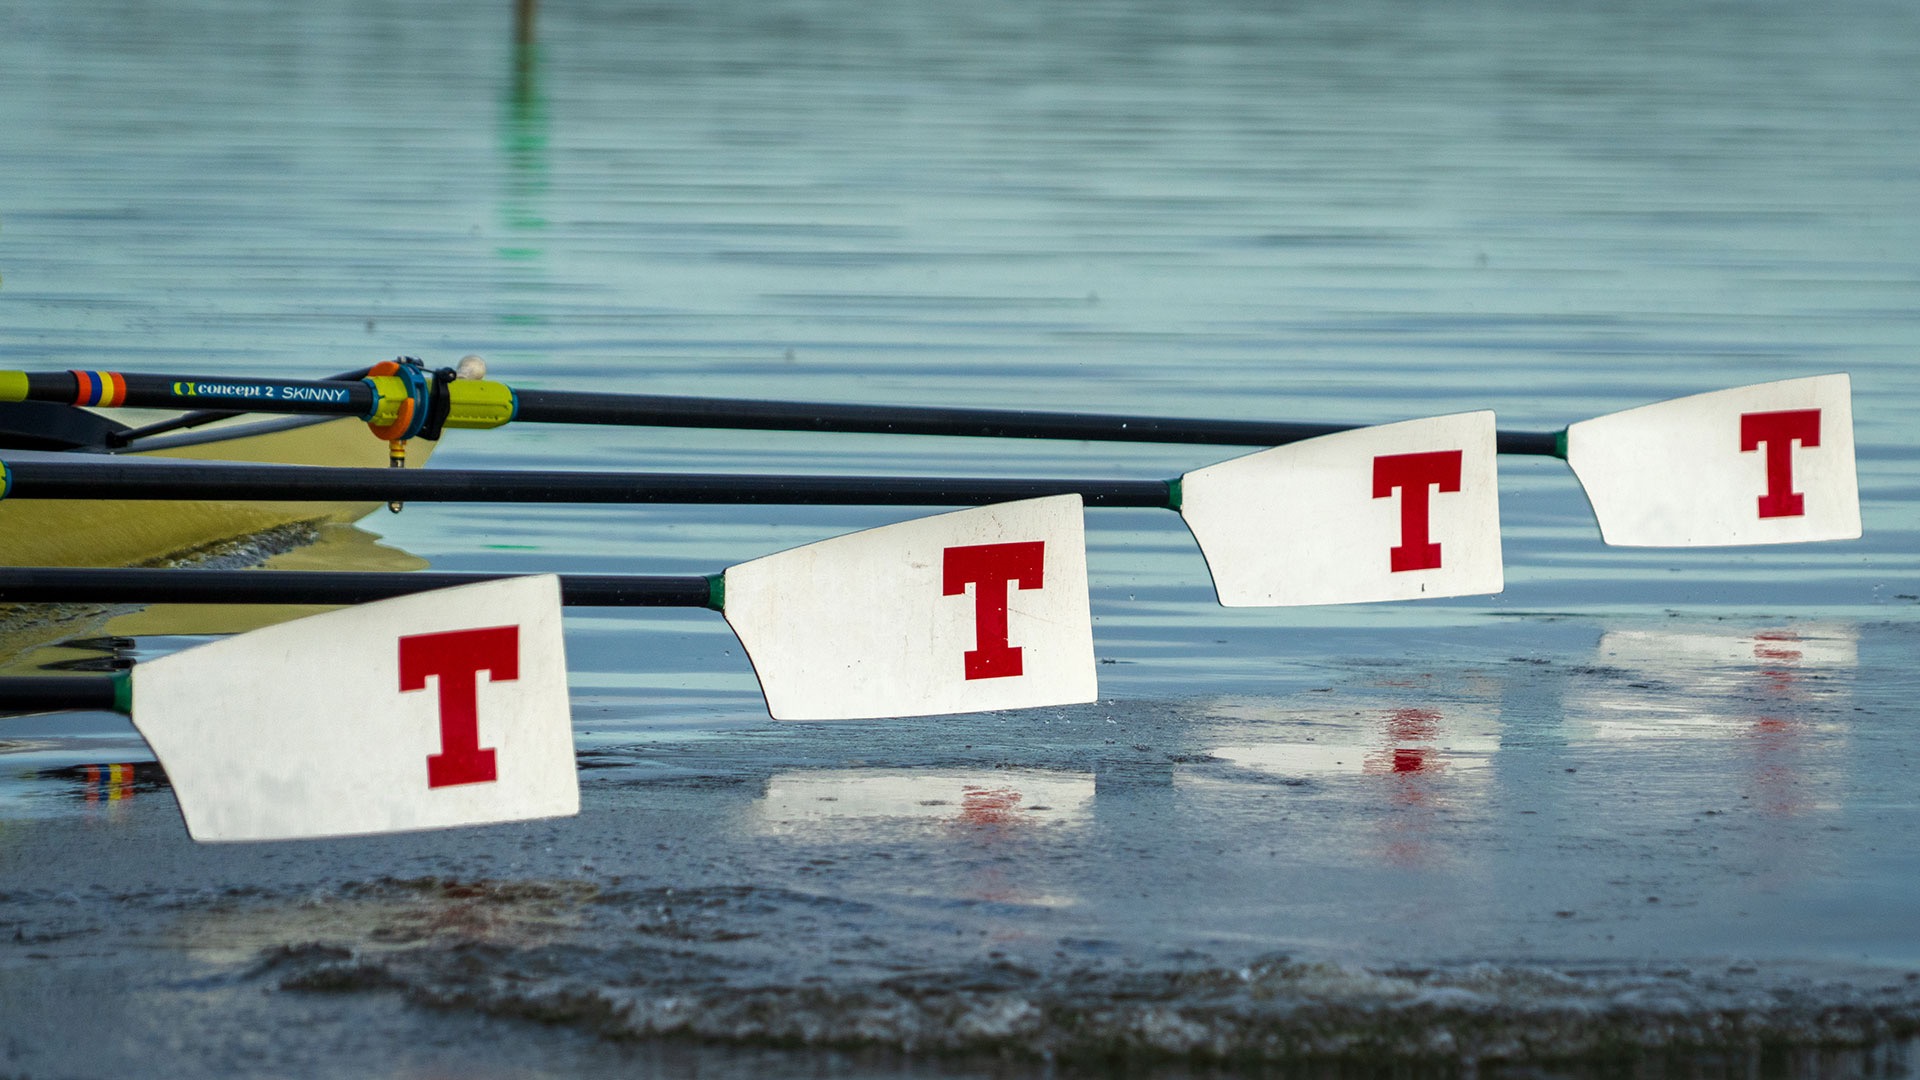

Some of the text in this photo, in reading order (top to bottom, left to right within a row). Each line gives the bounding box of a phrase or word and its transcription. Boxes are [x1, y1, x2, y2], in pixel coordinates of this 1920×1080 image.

[198, 383, 346, 401] concept 2 SKINNY
[1372, 450, 1463, 573] T
[1740, 409, 1821, 519] T
[942, 541, 1045, 681] T
[399, 625, 519, 788] T
